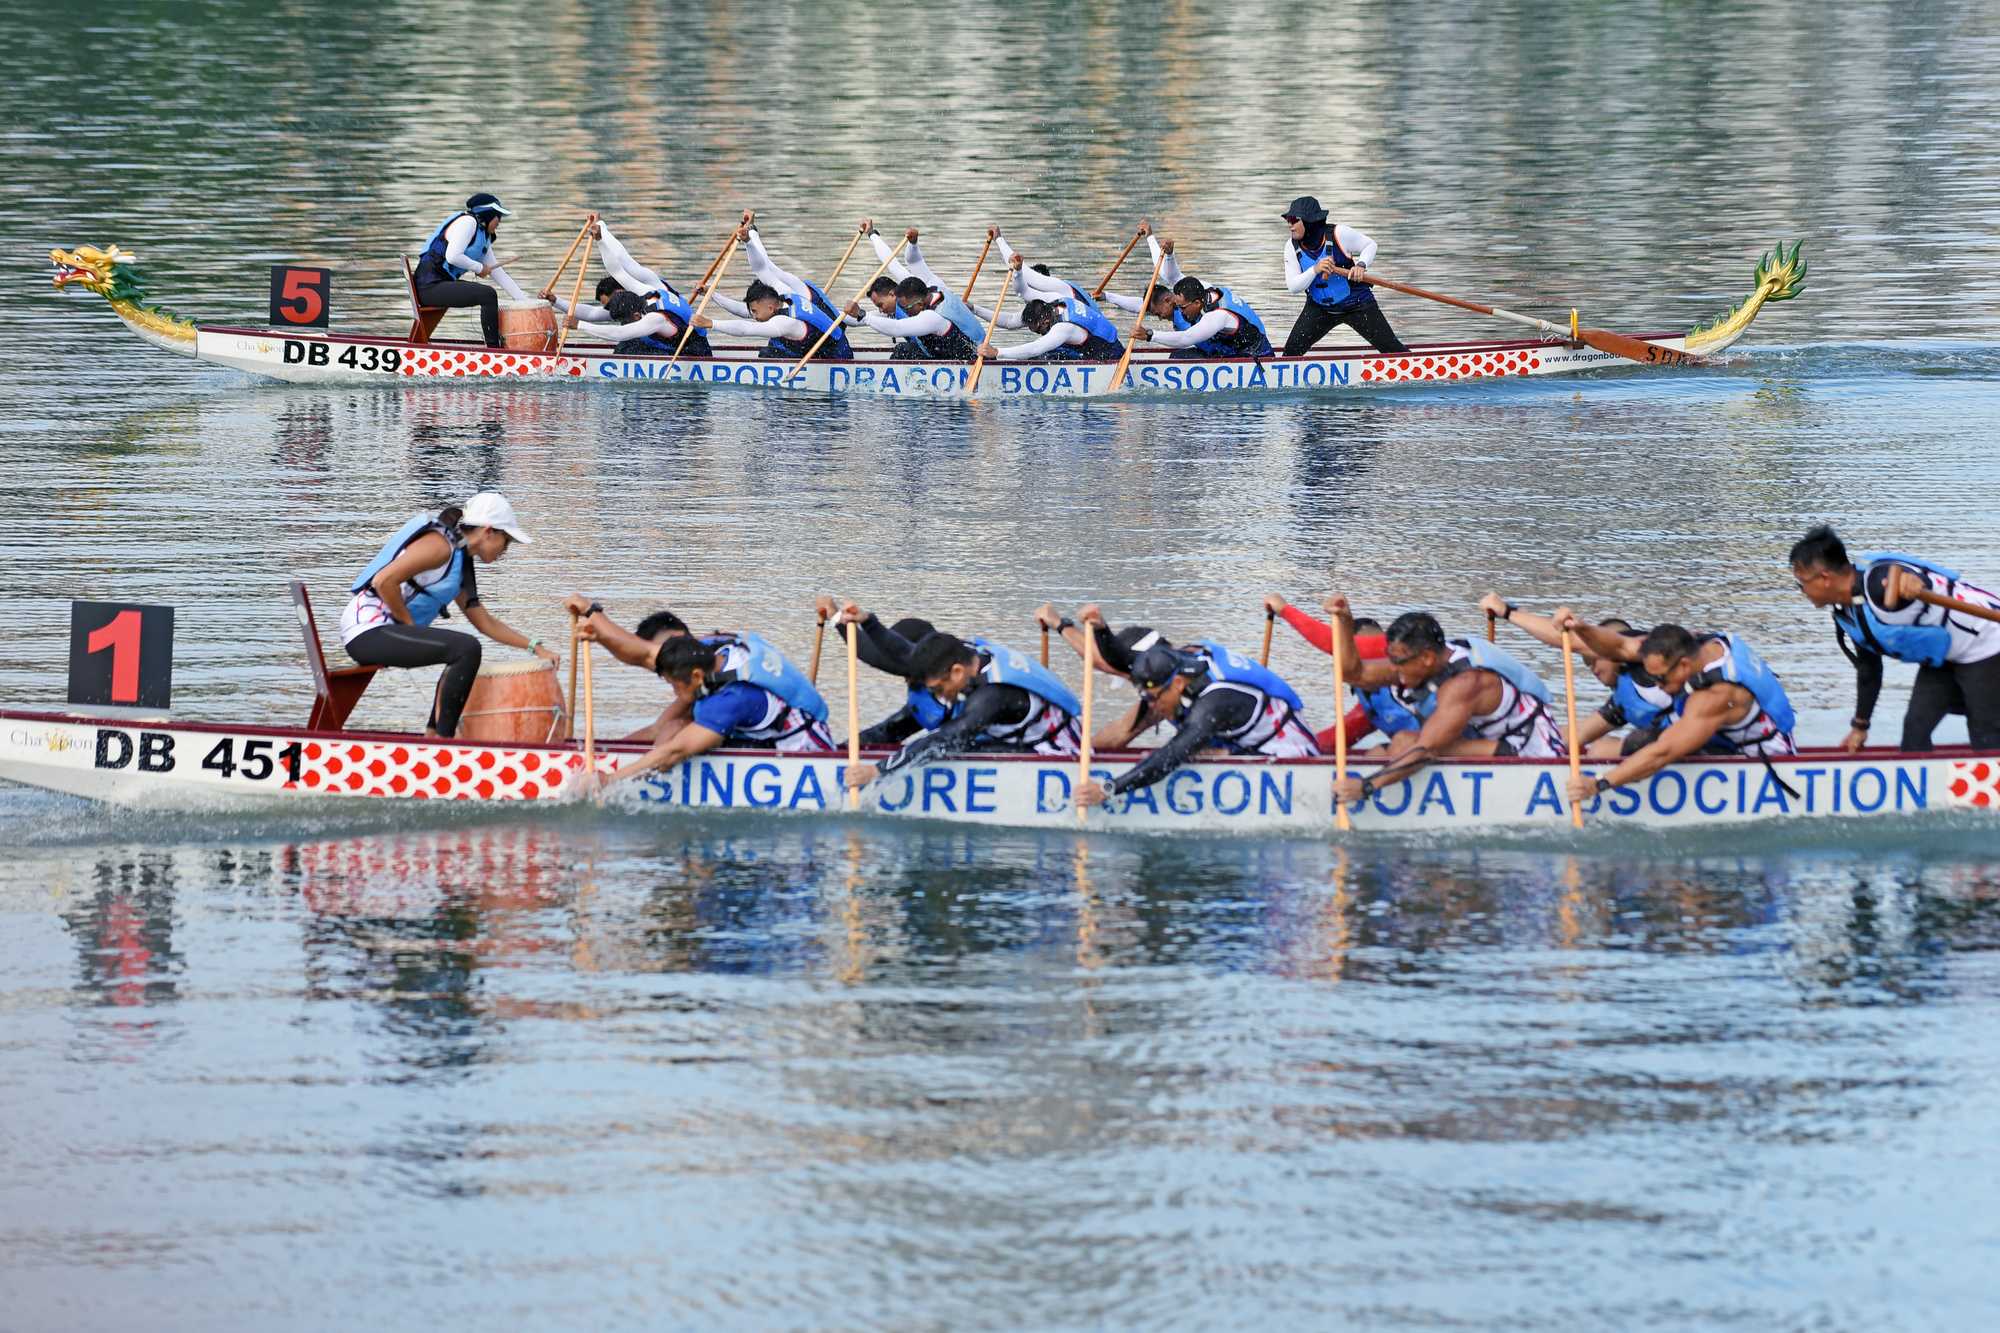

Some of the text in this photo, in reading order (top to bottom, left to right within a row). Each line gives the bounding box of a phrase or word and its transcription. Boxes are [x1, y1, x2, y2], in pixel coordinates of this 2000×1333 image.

[280, 269, 322, 323] 5
[284, 340, 402, 372] DB 439
[1001, 367, 1096, 394] BOAT
[87, 610, 142, 702] 1
[95, 729, 303, 782] DB 451
